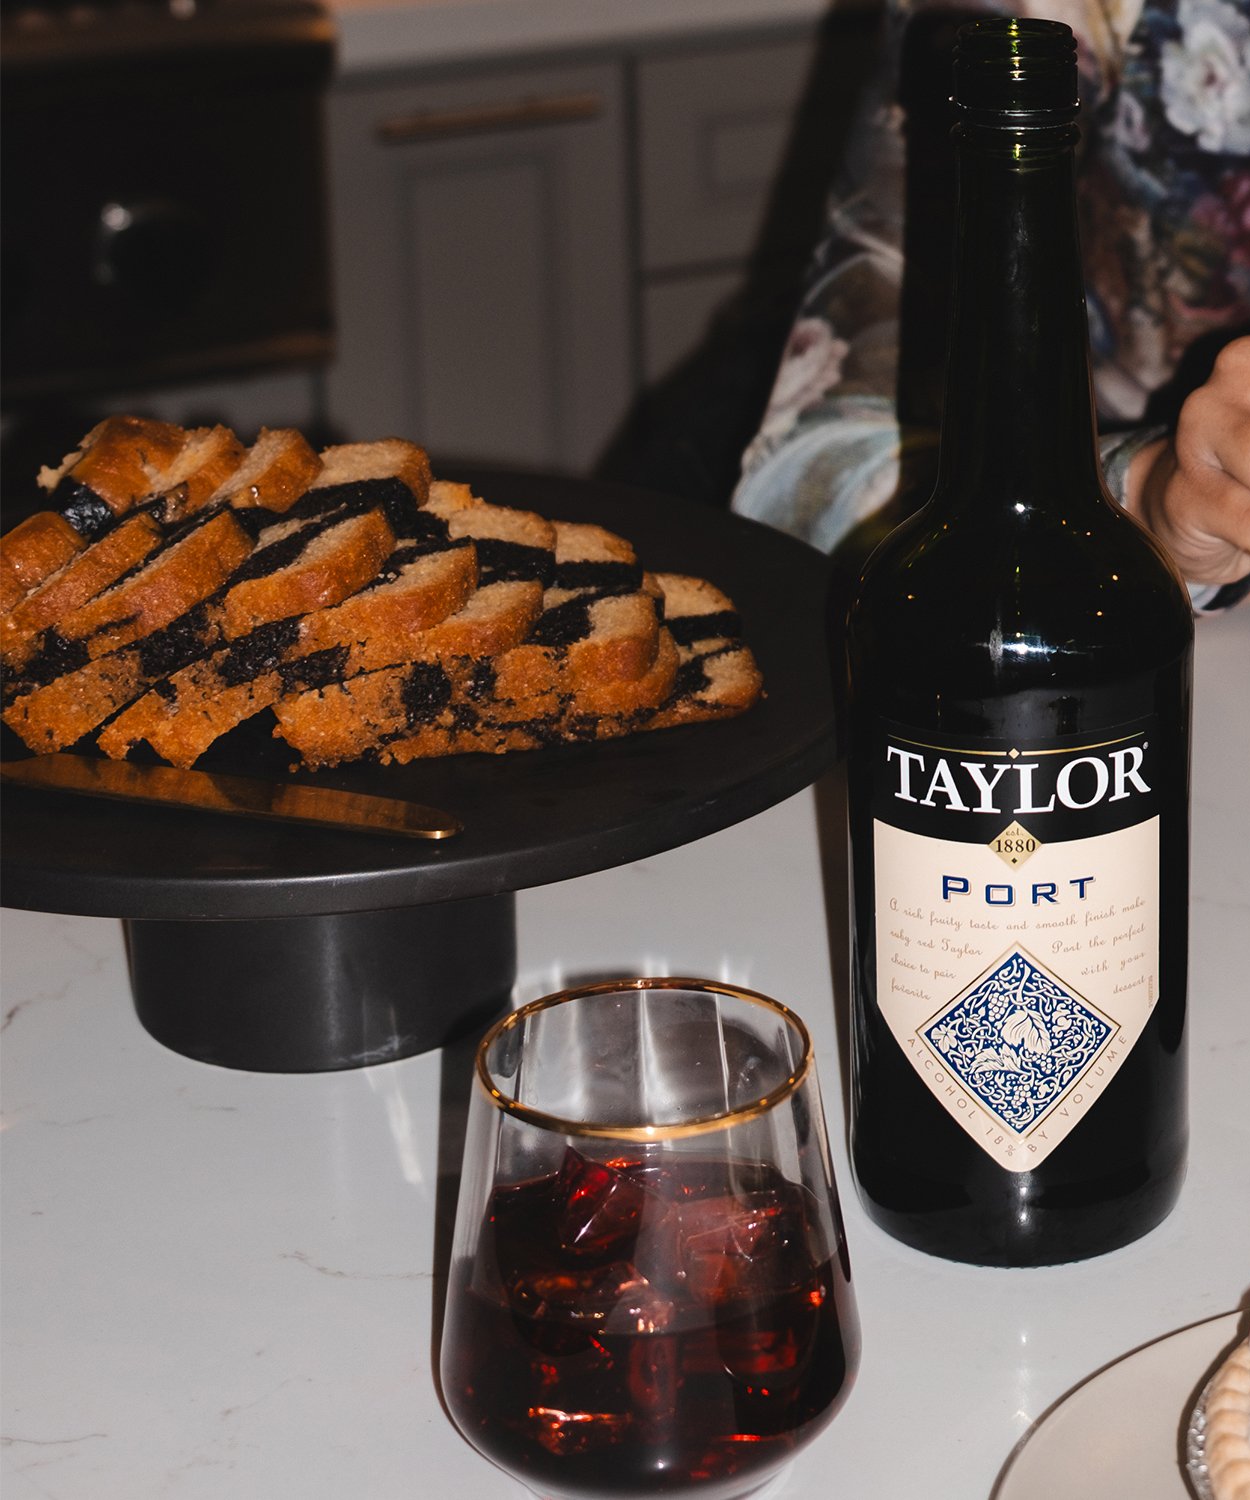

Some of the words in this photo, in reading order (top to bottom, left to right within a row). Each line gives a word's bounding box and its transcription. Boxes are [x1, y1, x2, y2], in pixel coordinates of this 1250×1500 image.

[886, 744, 1152, 814] TAYLOR
[995, 838, 1036, 853] 1880
[941, 875, 1095, 906] PORT
[903, 907, 924, 920] rich
[930, 911, 963, 932] fruity
[969, 919, 999, 930] taste
[1006, 919, 1028, 930] and
[1035, 914, 1078, 930] smooth
[1085, 905, 1117, 927] finish
[1122, 896, 1146, 913] make
[890, 929, 912, 947] ruby
[917, 939, 935, 949] red
[941, 937, 984, 958] Taylor
[1051, 940, 1082, 954] Port
[1088, 935, 1106, 949] the
[1112, 923, 1146, 946] perfect
[891, 953, 917, 970] choice
[919, 963, 930, 974] to
[934, 969, 957, 979] pair
[1080, 960, 1110, 976] with
[1120, 951, 1146, 971] your
[891, 977, 932, 1001] favorite
[1112, 975, 1147, 995] dessert
[907, 1037, 977, 1120] ALCOHOL
[986, 1126, 1017, 1157] 18%
[1026, 1130, 1049, 1153] BY
[1059, 1034, 1128, 1118] VOLUME
